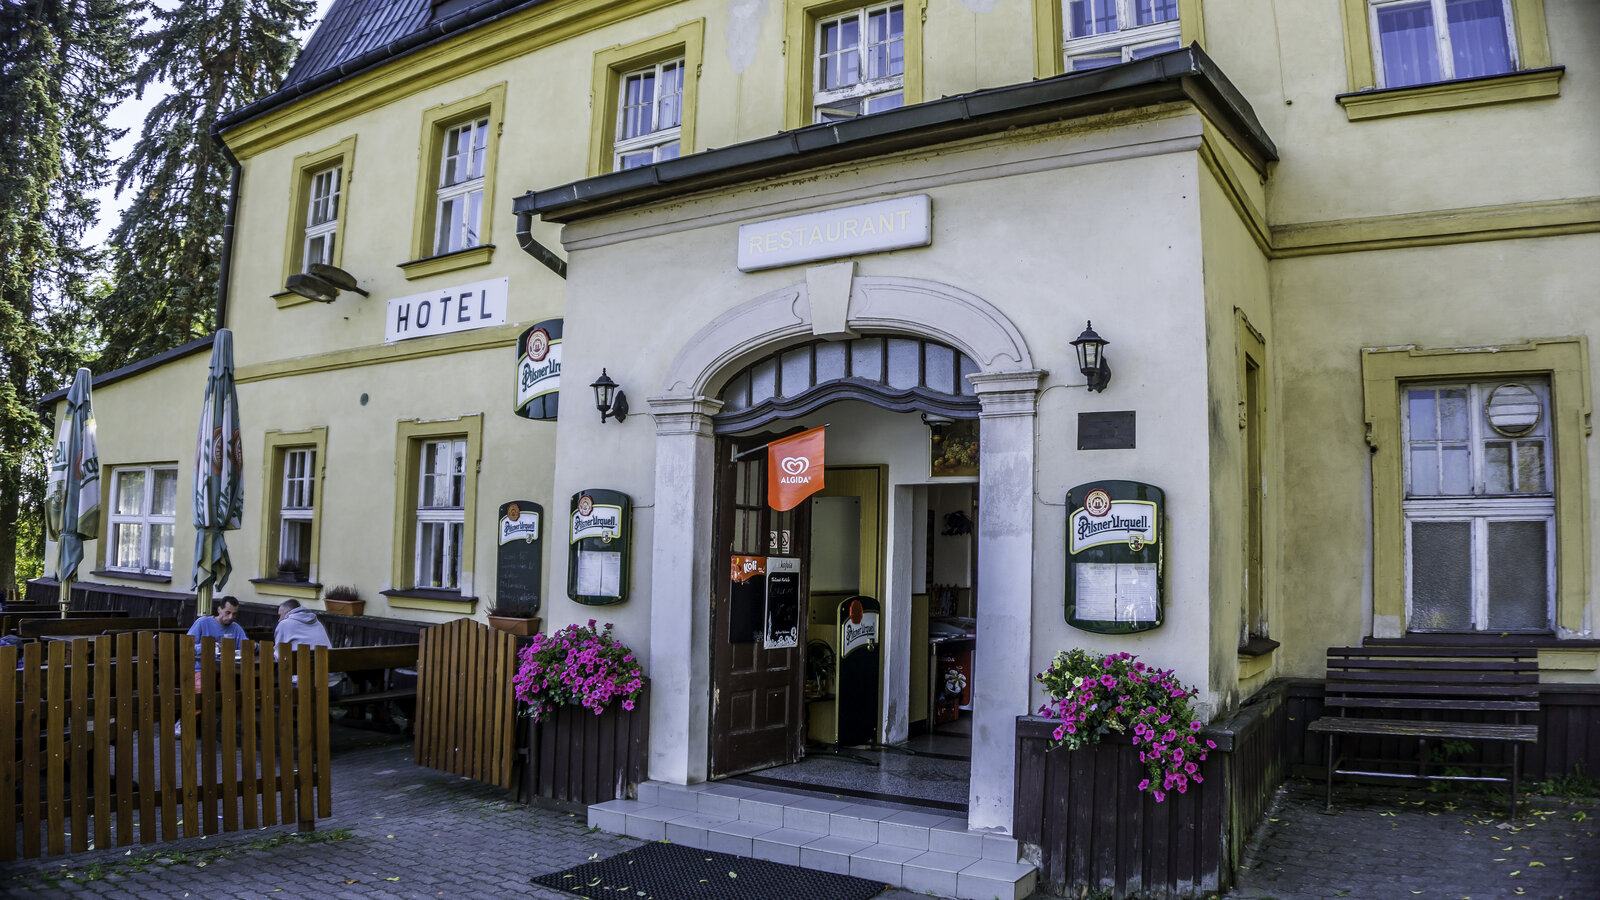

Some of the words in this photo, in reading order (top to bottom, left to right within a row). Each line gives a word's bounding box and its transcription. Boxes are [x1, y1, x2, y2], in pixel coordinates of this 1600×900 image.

[749, 209, 911, 254] RESTAURANT
[397, 289, 492, 333] HOTEL
[522, 362, 549, 393] Pilsner
[504, 521, 520, 537] Pilsner
[519, 520, 535, 533] Urquell
[574, 516, 593, 535] Pilsner
[592, 515, 616, 529] Urquell
[1077, 515, 1112, 541] Pilsner
[1111, 514, 1147, 533] Urquell
[846, 624, 861, 646] Pilsner
[860, 622, 875, 636] Urquell
